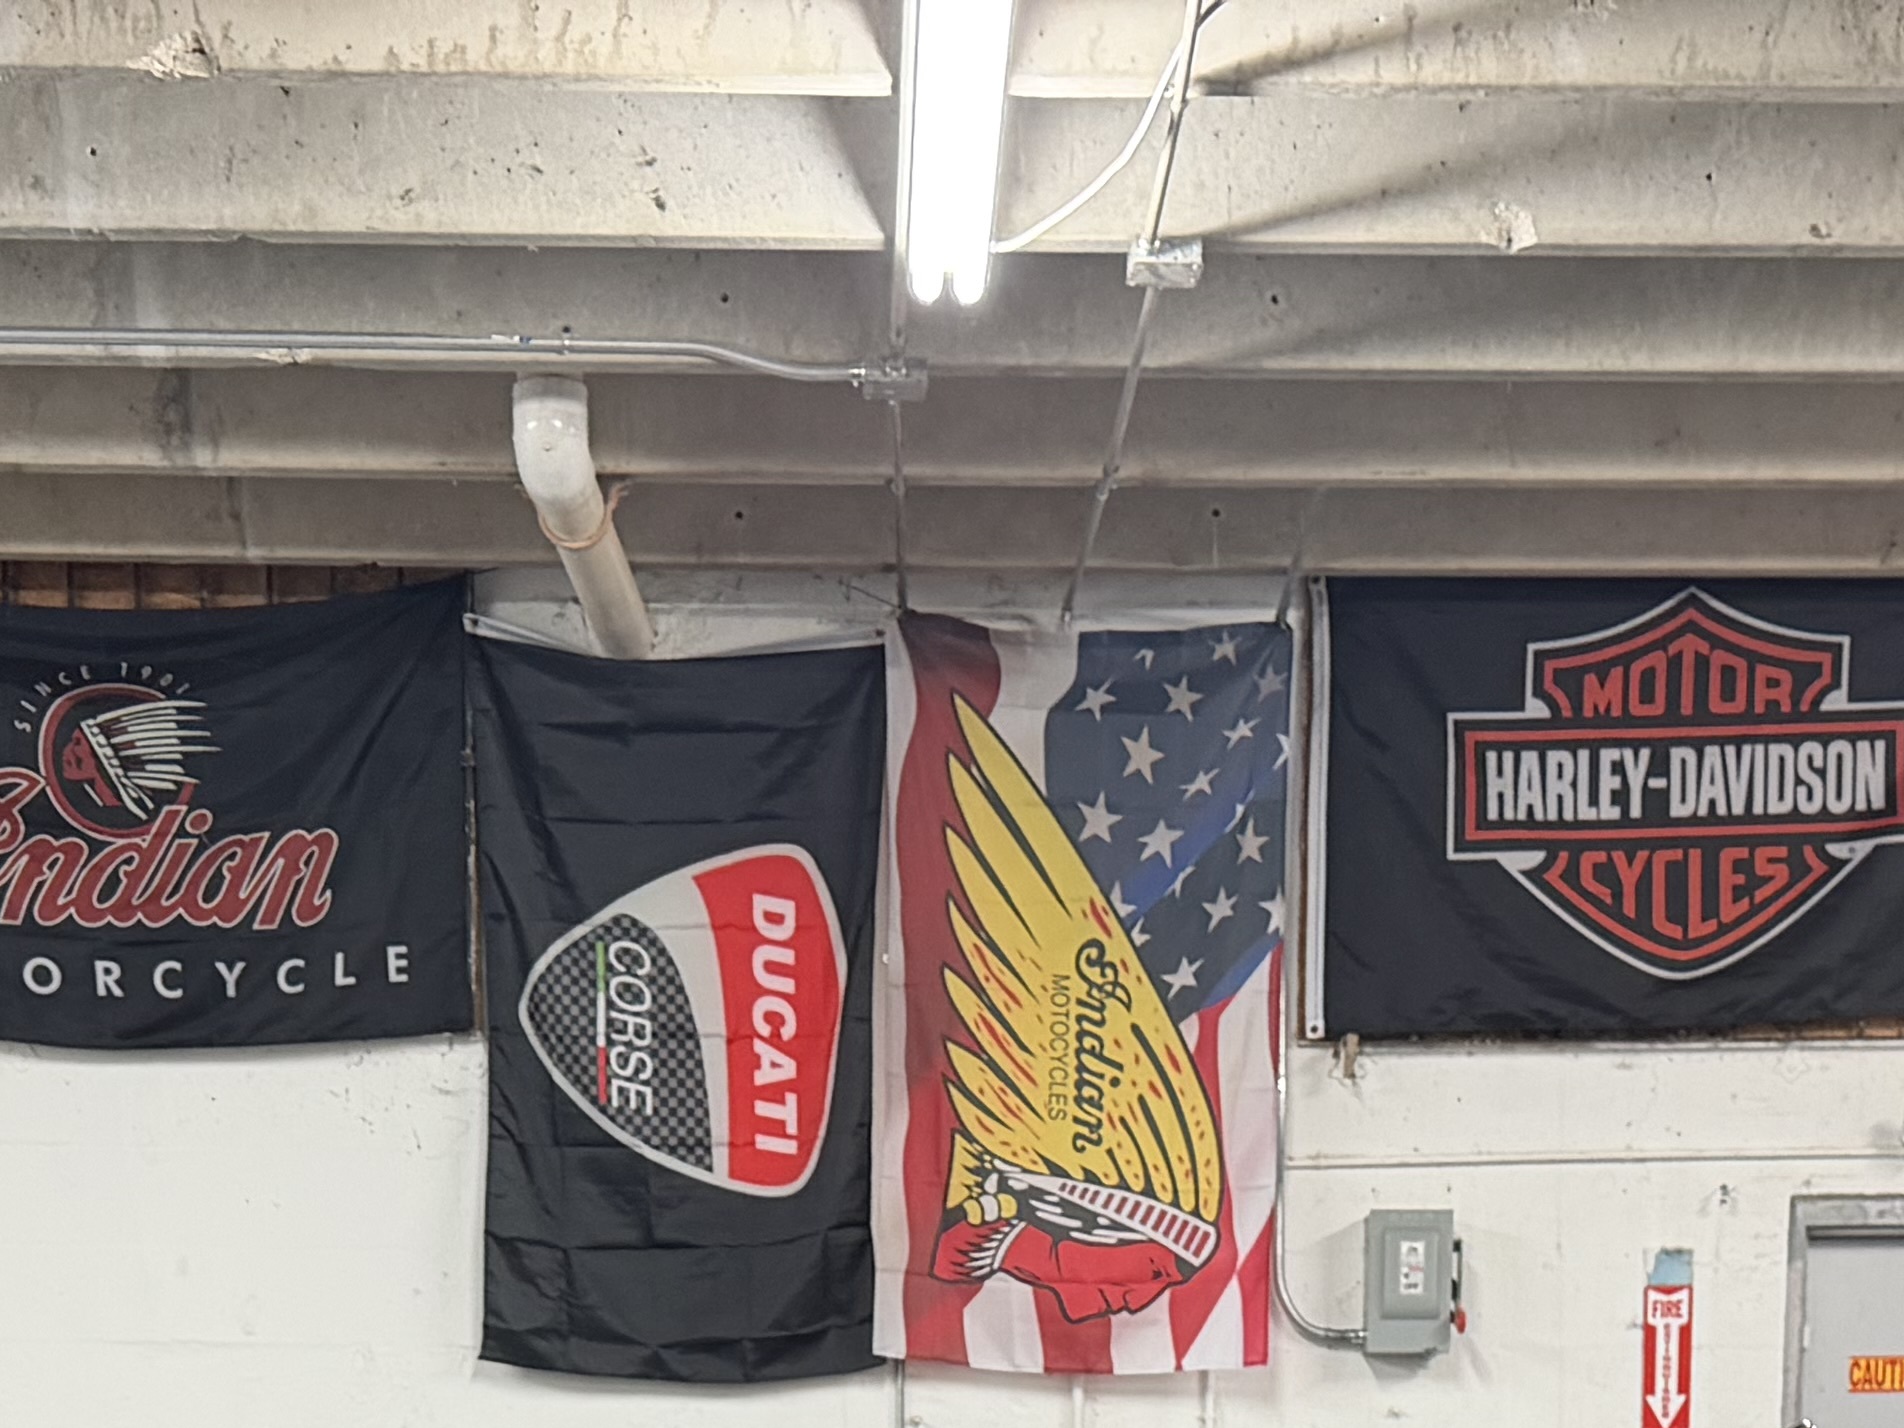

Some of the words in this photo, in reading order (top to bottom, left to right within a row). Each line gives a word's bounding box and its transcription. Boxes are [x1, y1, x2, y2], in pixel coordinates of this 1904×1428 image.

[15, 664, 92, 734] SINCE
[120, 661, 191, 698] 1901
[1582, 632, 1793, 719] MOTOR
[1485, 738, 1888, 822] HARLEY-DAVIDSON
[1579, 845, 1791, 940] CYCLES
[607, 939, 653, 1117] CORSE
[751, 893, 798, 1156] DUCATI
[1046, 972, 1071, 1123] MOTOCYCLES
[1066, 937, 1132, 1155] Indian
[1652, 1300, 1683, 1319] FIRE
